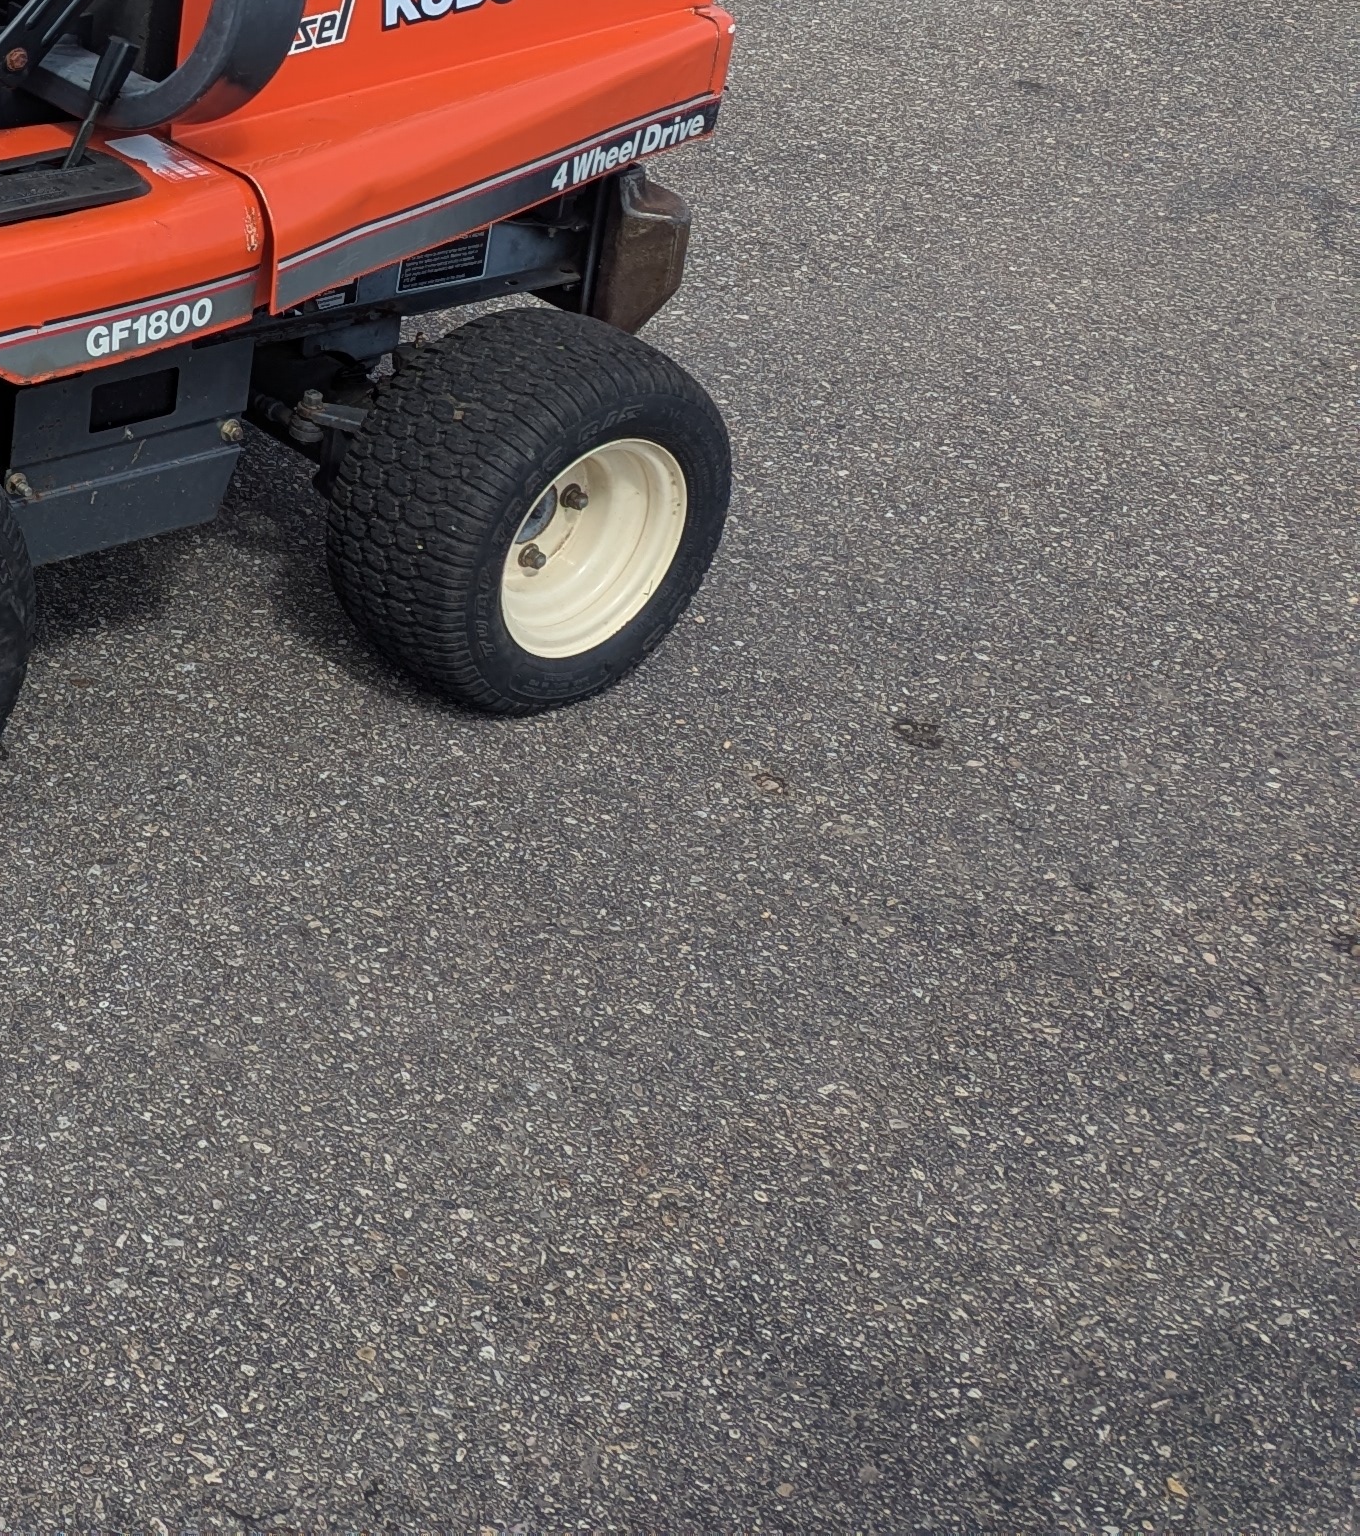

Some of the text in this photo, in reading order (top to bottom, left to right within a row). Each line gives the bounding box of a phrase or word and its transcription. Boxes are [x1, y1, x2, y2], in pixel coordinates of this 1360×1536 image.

[551, 114, 705, 191] 4 Wheel Drive
[86, 297, 213, 357] GF1800
